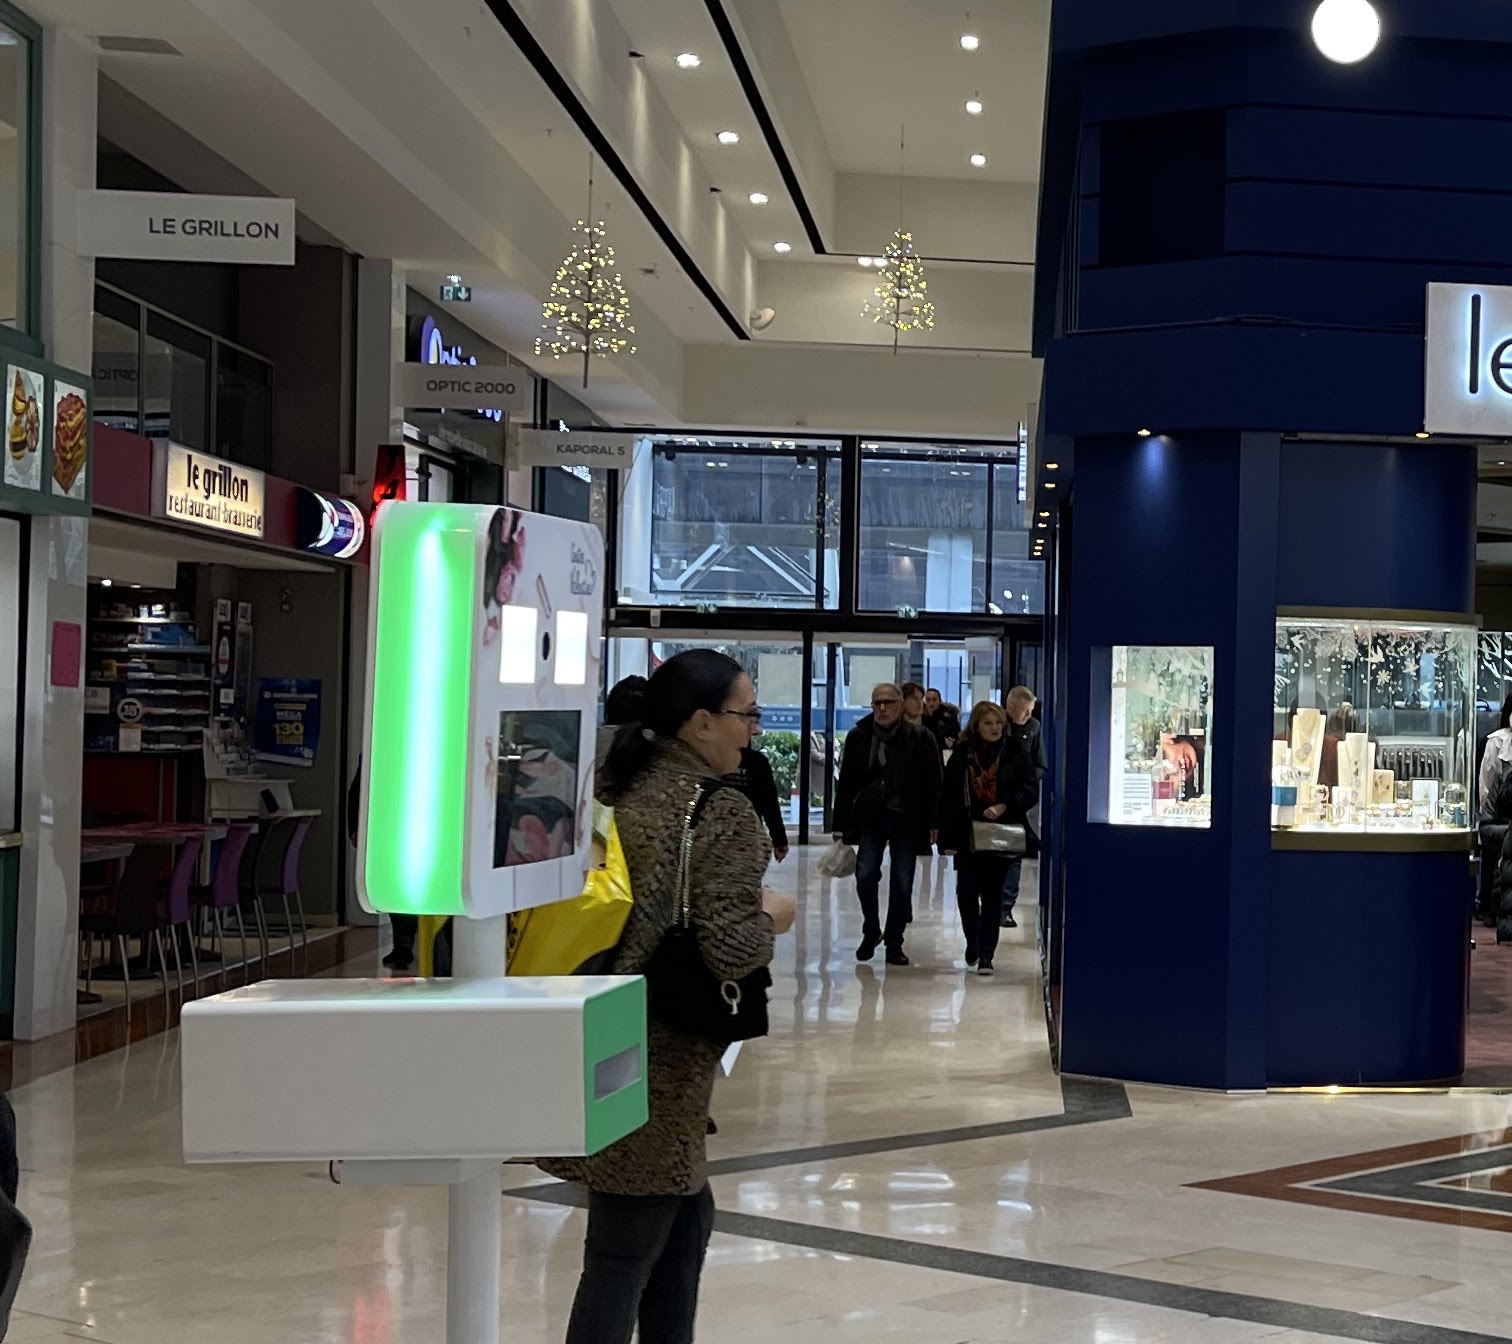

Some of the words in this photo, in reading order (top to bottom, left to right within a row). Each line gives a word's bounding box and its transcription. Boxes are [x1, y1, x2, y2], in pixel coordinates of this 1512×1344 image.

[149, 218, 176, 235] LE
[181, 219, 279, 239] GRILLON
[426, 380, 471, 393] OPTIC
[474, 381, 516, 394] 2000
[556, 444, 614, 456] KAPORAL
[617, 446, 625, 456] 5
[187, 454, 199, 490] le
[203, 464, 249, 502] grillon
